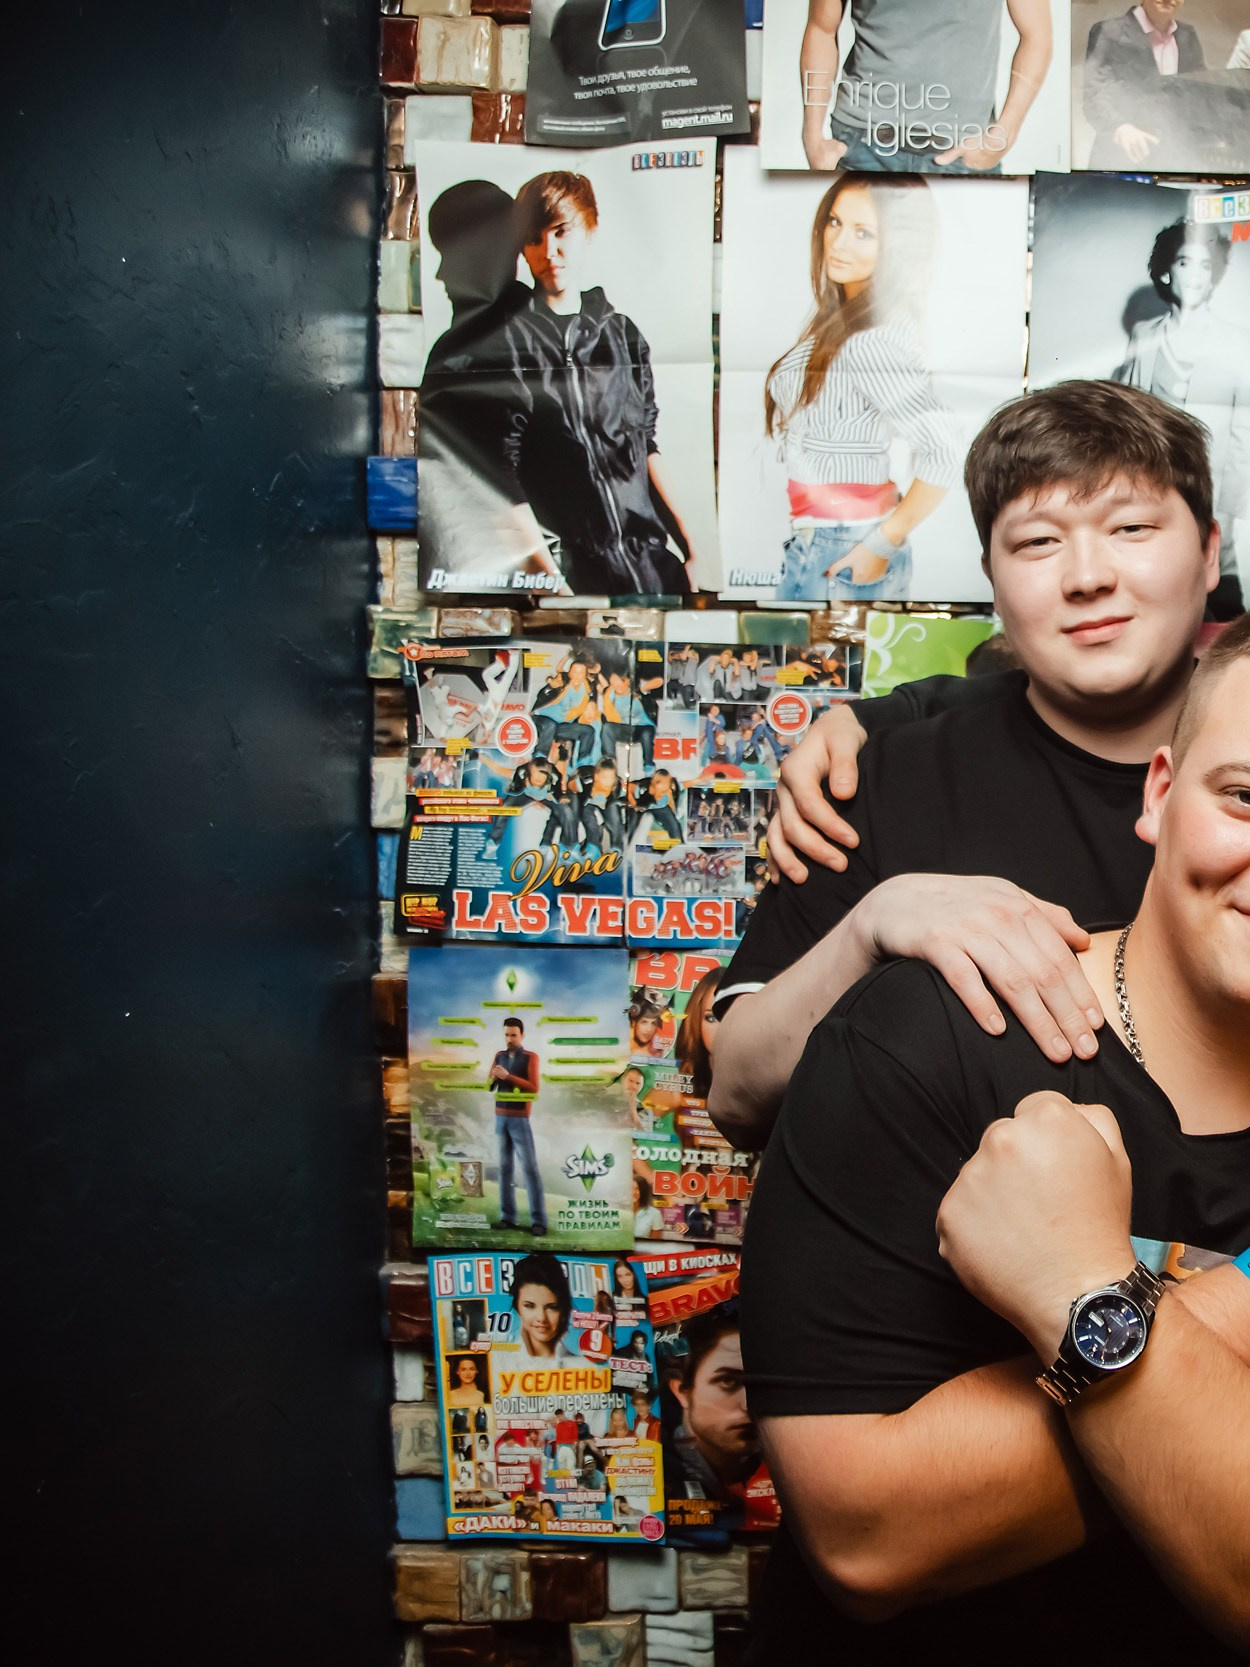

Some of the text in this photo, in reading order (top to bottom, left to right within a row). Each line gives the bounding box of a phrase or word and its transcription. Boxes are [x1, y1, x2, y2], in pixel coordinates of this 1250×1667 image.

[648, 64, 691, 77] общение,
[636, 77, 698, 93] удовольствие
[804, 70, 951, 117] Enrique
[662, 112, 733, 129] magent.mail.ru
[864, 112, 1008, 156] Iglesias
[512, 569, 566, 593] Бибер
[730, 568, 785, 586] Нюша
[510, 844, 622, 900] Viva
[453, 890, 551, 935] LAS
[559, 893, 737, 940] VEGAS!
[567, 1155, 608, 1178] SIMS
[568, 1199, 609, 1208] ЖИЗНЬ
[558, 1210, 620, 1219] ПО ТВОИМ
[558, 1221, 621, 1231] ПРАВИЛАМ
[681, 1253, 737, 1271] КИОСКАХ
[488, 1311, 511, 1333] 10
[611, 1358, 653, 1373] ТЕСТ:
[501, 1373, 515, 1394] У
[521, 1370, 609, 1393] СЕЛЕНЫ
[493, 1392, 627, 1415] большие перемены
[454, 1516, 527, 1534] «ДАКИ»
[546, 1521, 614, 1534] макаки
